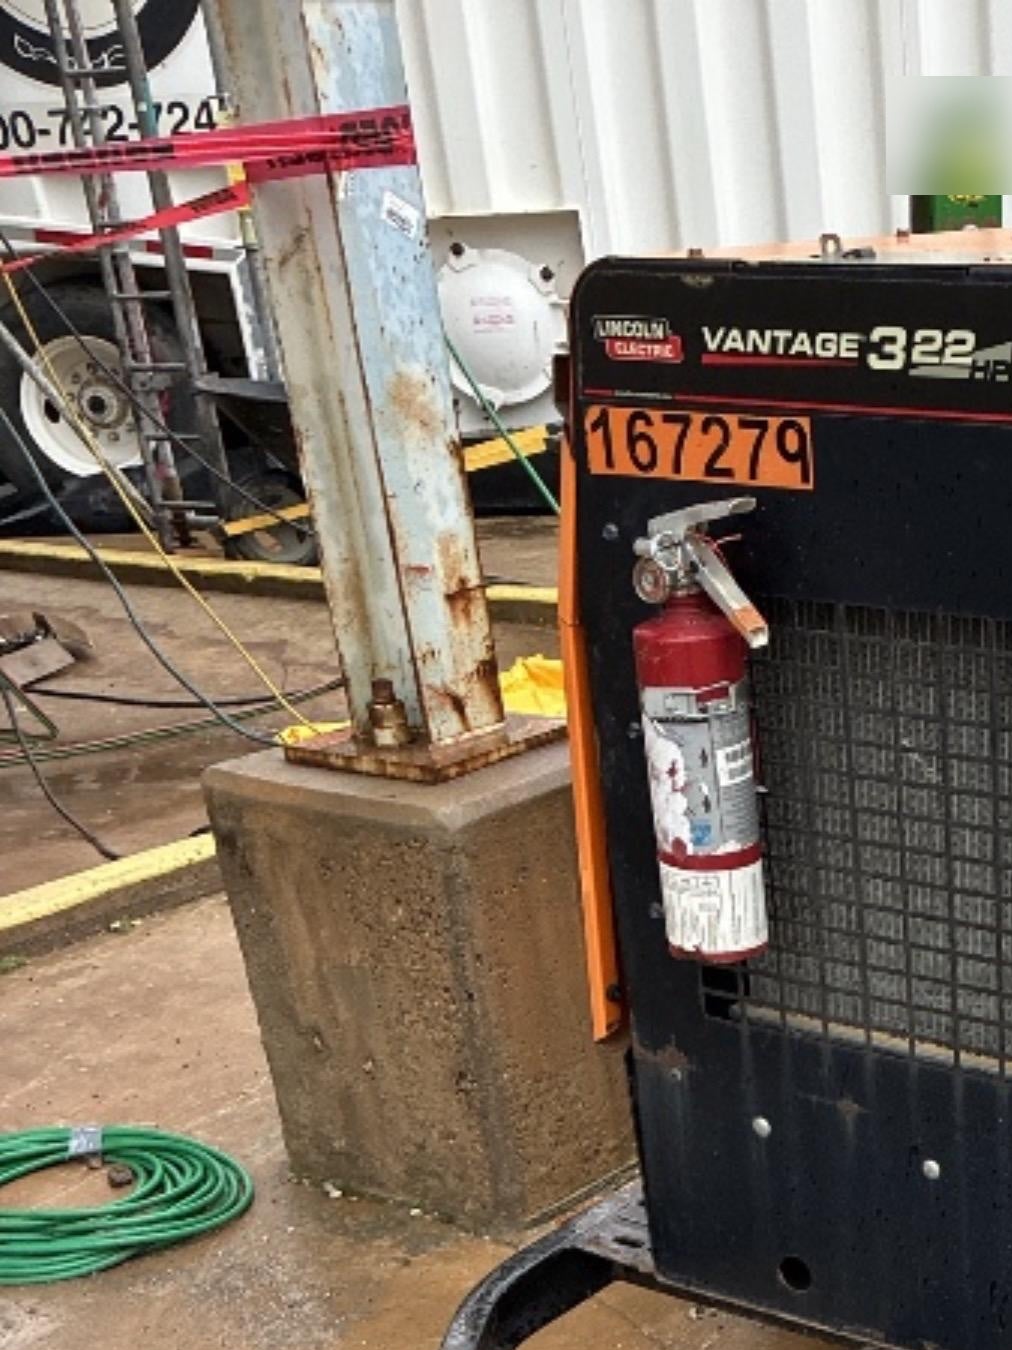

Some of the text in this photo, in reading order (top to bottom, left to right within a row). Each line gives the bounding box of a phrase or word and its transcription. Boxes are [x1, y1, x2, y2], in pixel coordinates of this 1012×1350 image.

[597, 320, 664, 341] LINCOLN
[613, 341, 674, 358] ELECTRIC
[702, 326, 860, 357] VANTAGE
[866, 325, 976, 370] 322
[590, 406, 810, 484] 167279
